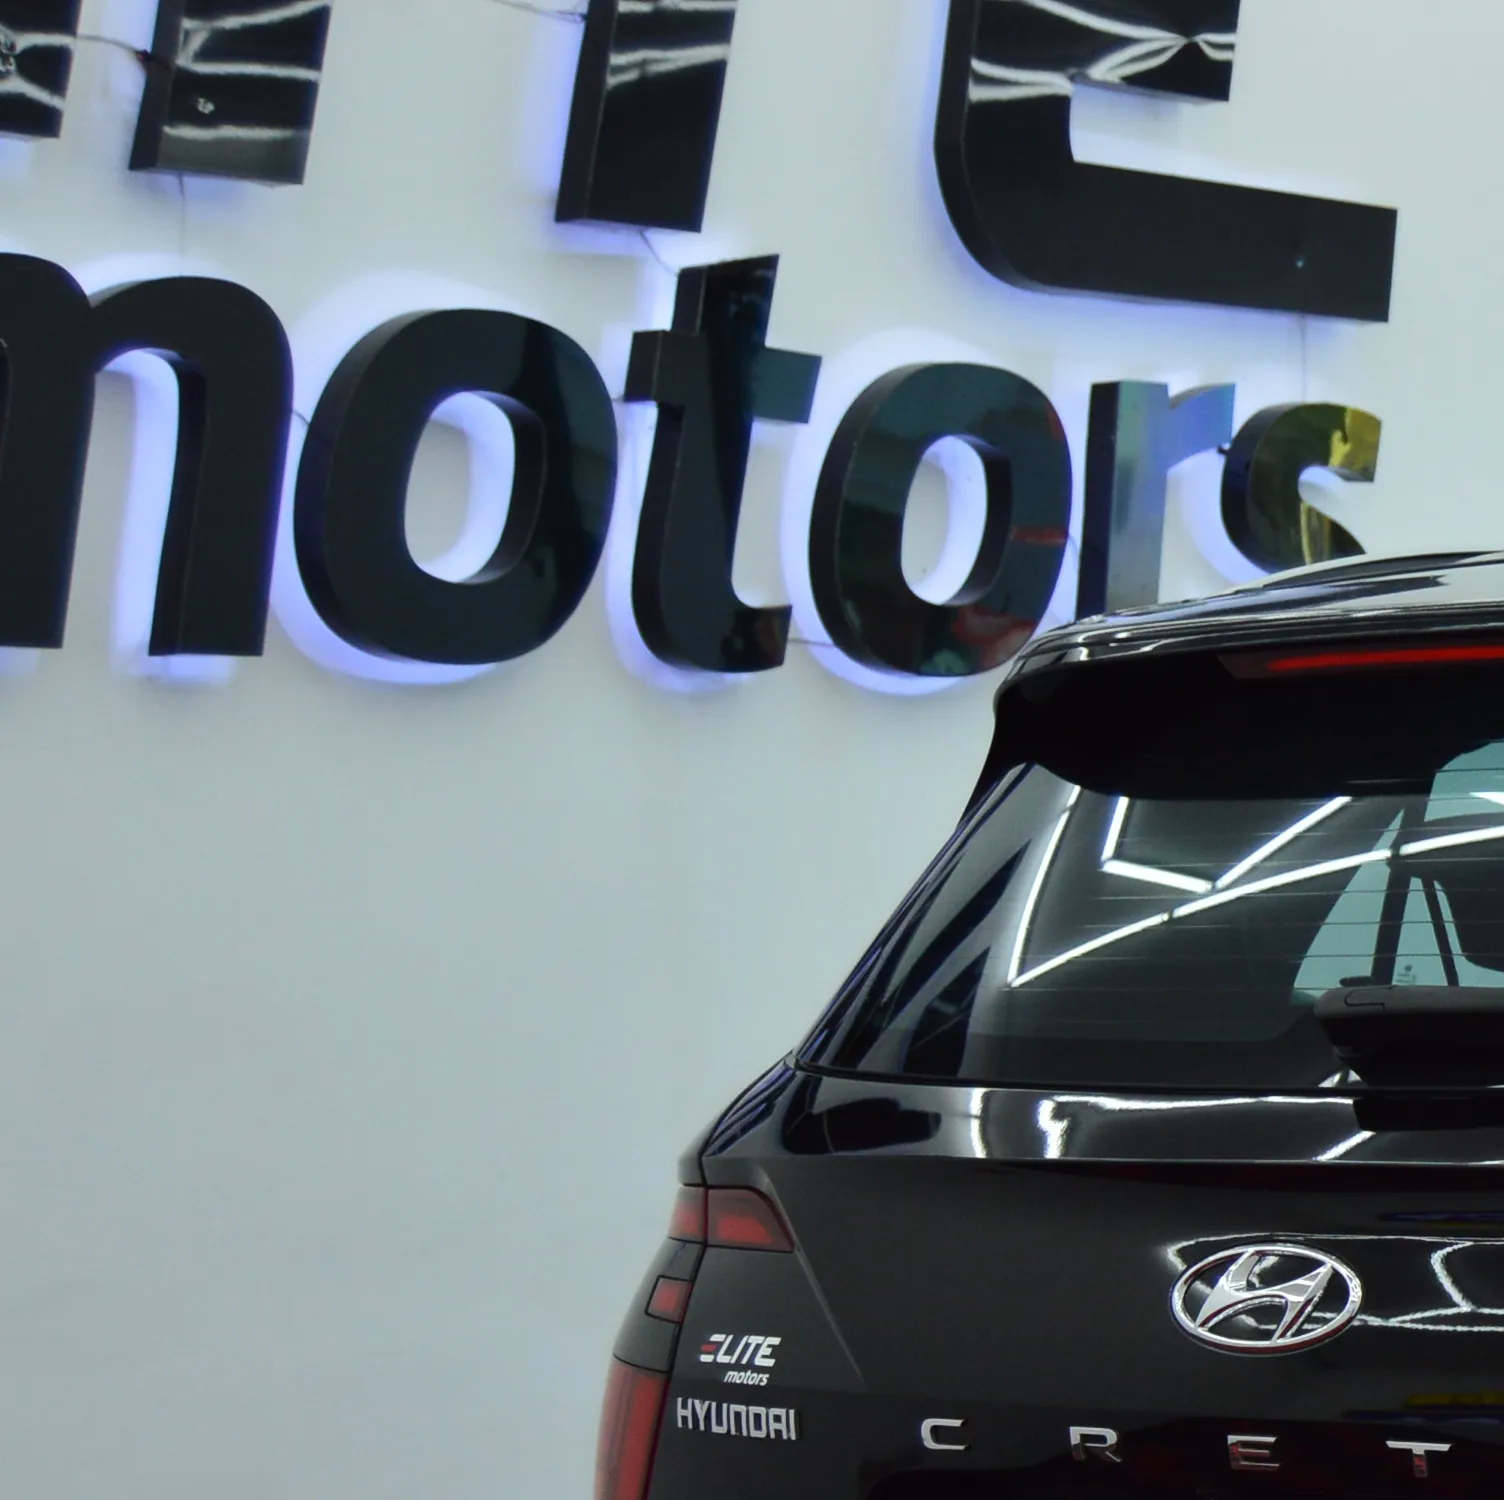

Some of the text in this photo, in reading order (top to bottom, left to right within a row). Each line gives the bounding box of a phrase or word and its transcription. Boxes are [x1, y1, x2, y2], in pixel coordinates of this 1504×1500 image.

[0, 250, 1384, 681] motors
[699, 1333, 782, 1367] ELITE
[724, 1369, 770, 1387] motors
[676, 1396, 797, 1441] HYUNDAI
